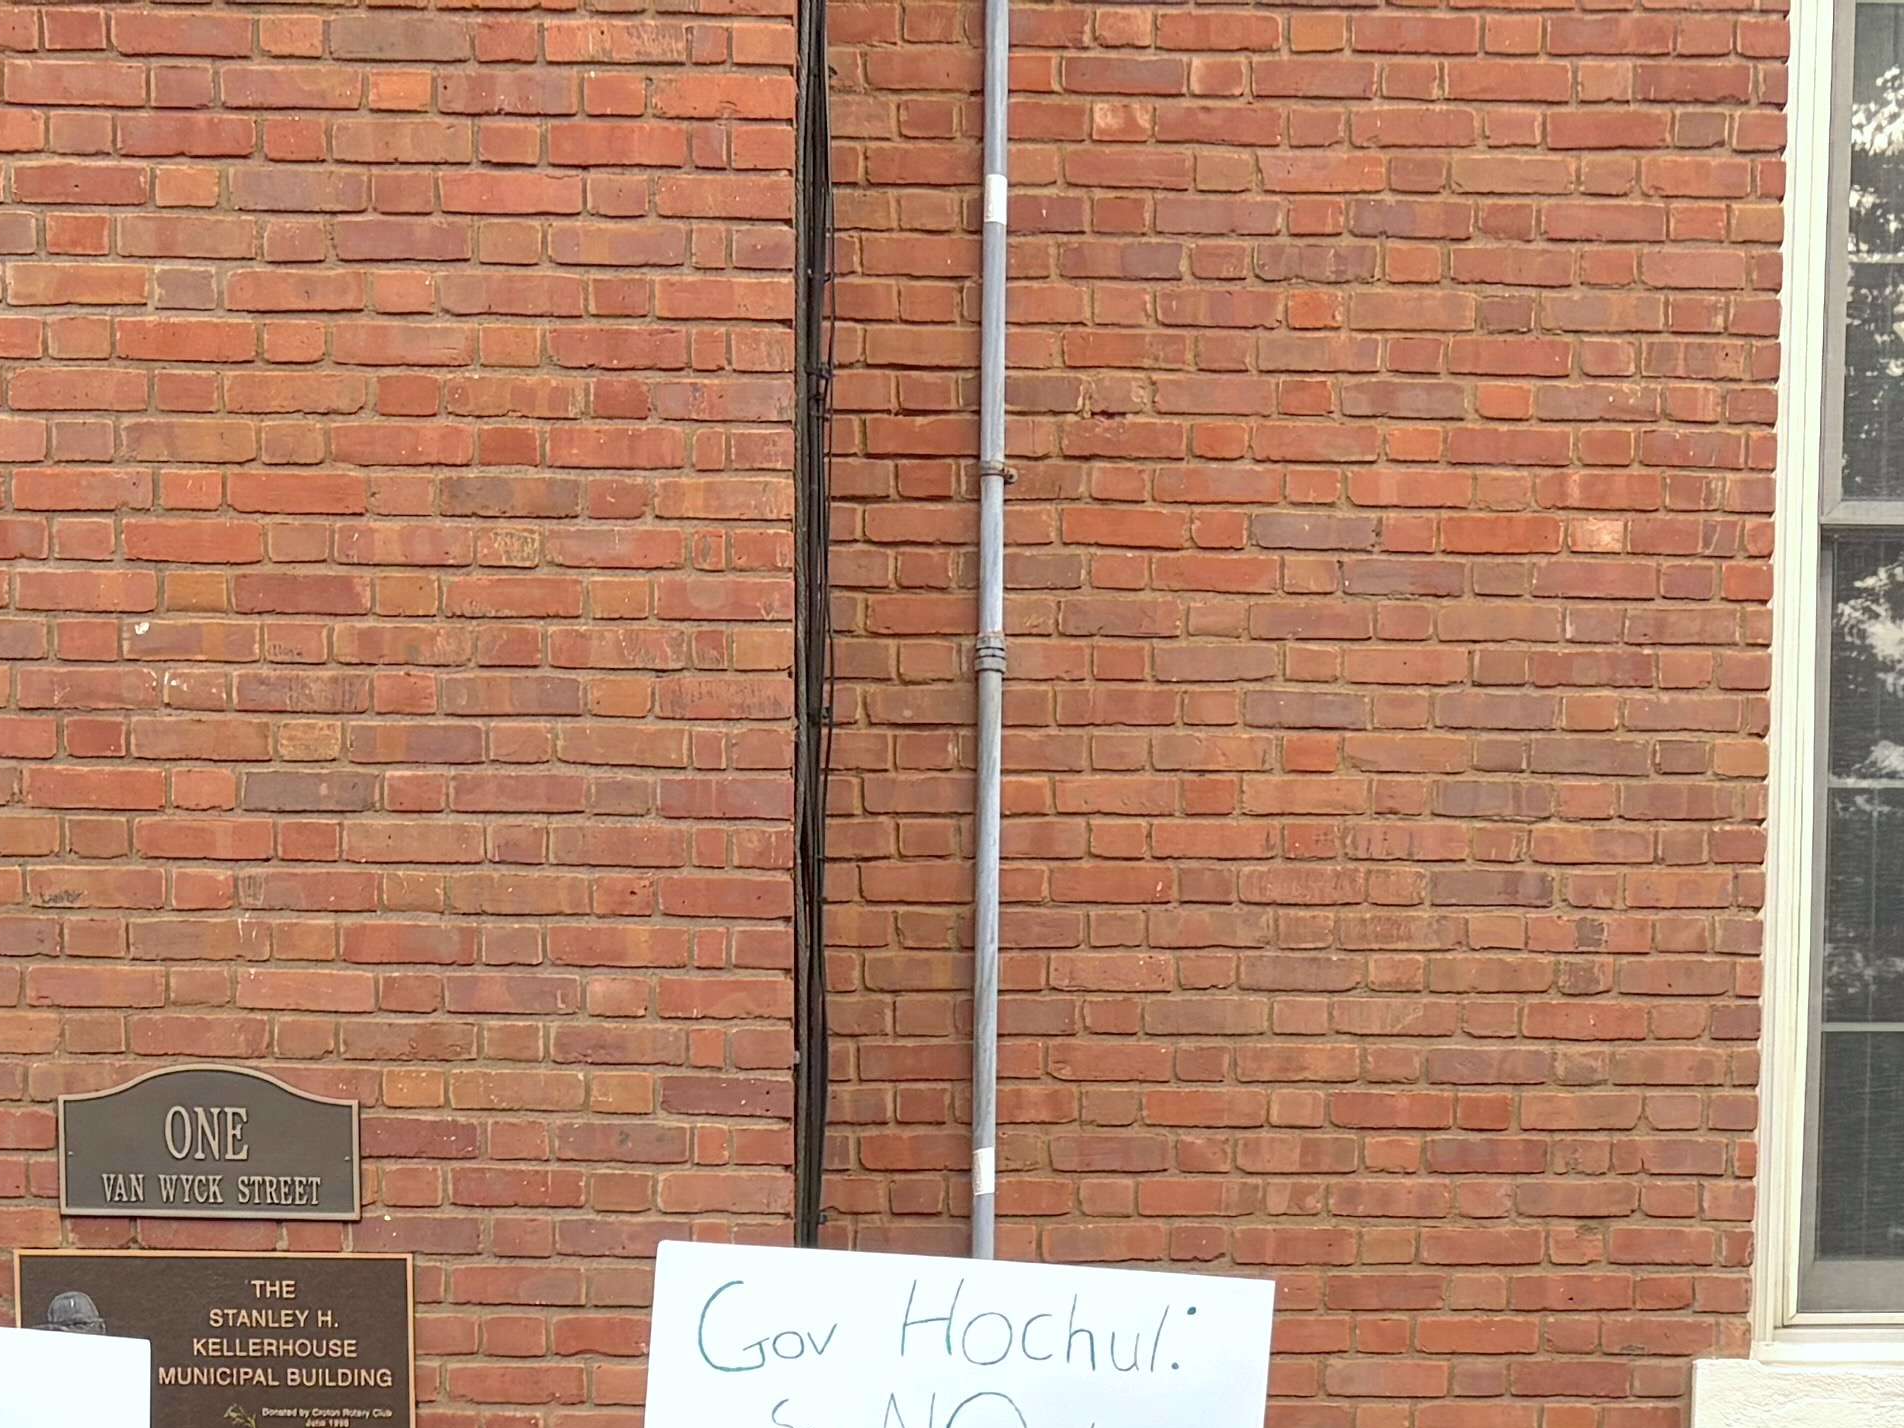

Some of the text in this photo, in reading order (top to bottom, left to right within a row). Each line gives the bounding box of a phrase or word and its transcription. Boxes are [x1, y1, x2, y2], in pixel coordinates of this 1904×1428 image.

[165, 1105, 249, 1161] ONE
[102, 1174, 321, 1205] VAN WYCK STREET
[252, 1280, 296, 1299] THE
[209, 1309, 339, 1328] STANLEY H.
[697, 1278, 1197, 1373] Gov Hochul:
[193, 1339, 358, 1358] KELLERHOUSE
[158, 1368, 393, 1388] MUNICIPAL BUILDING
[299, 1408, 309, 1418] by
